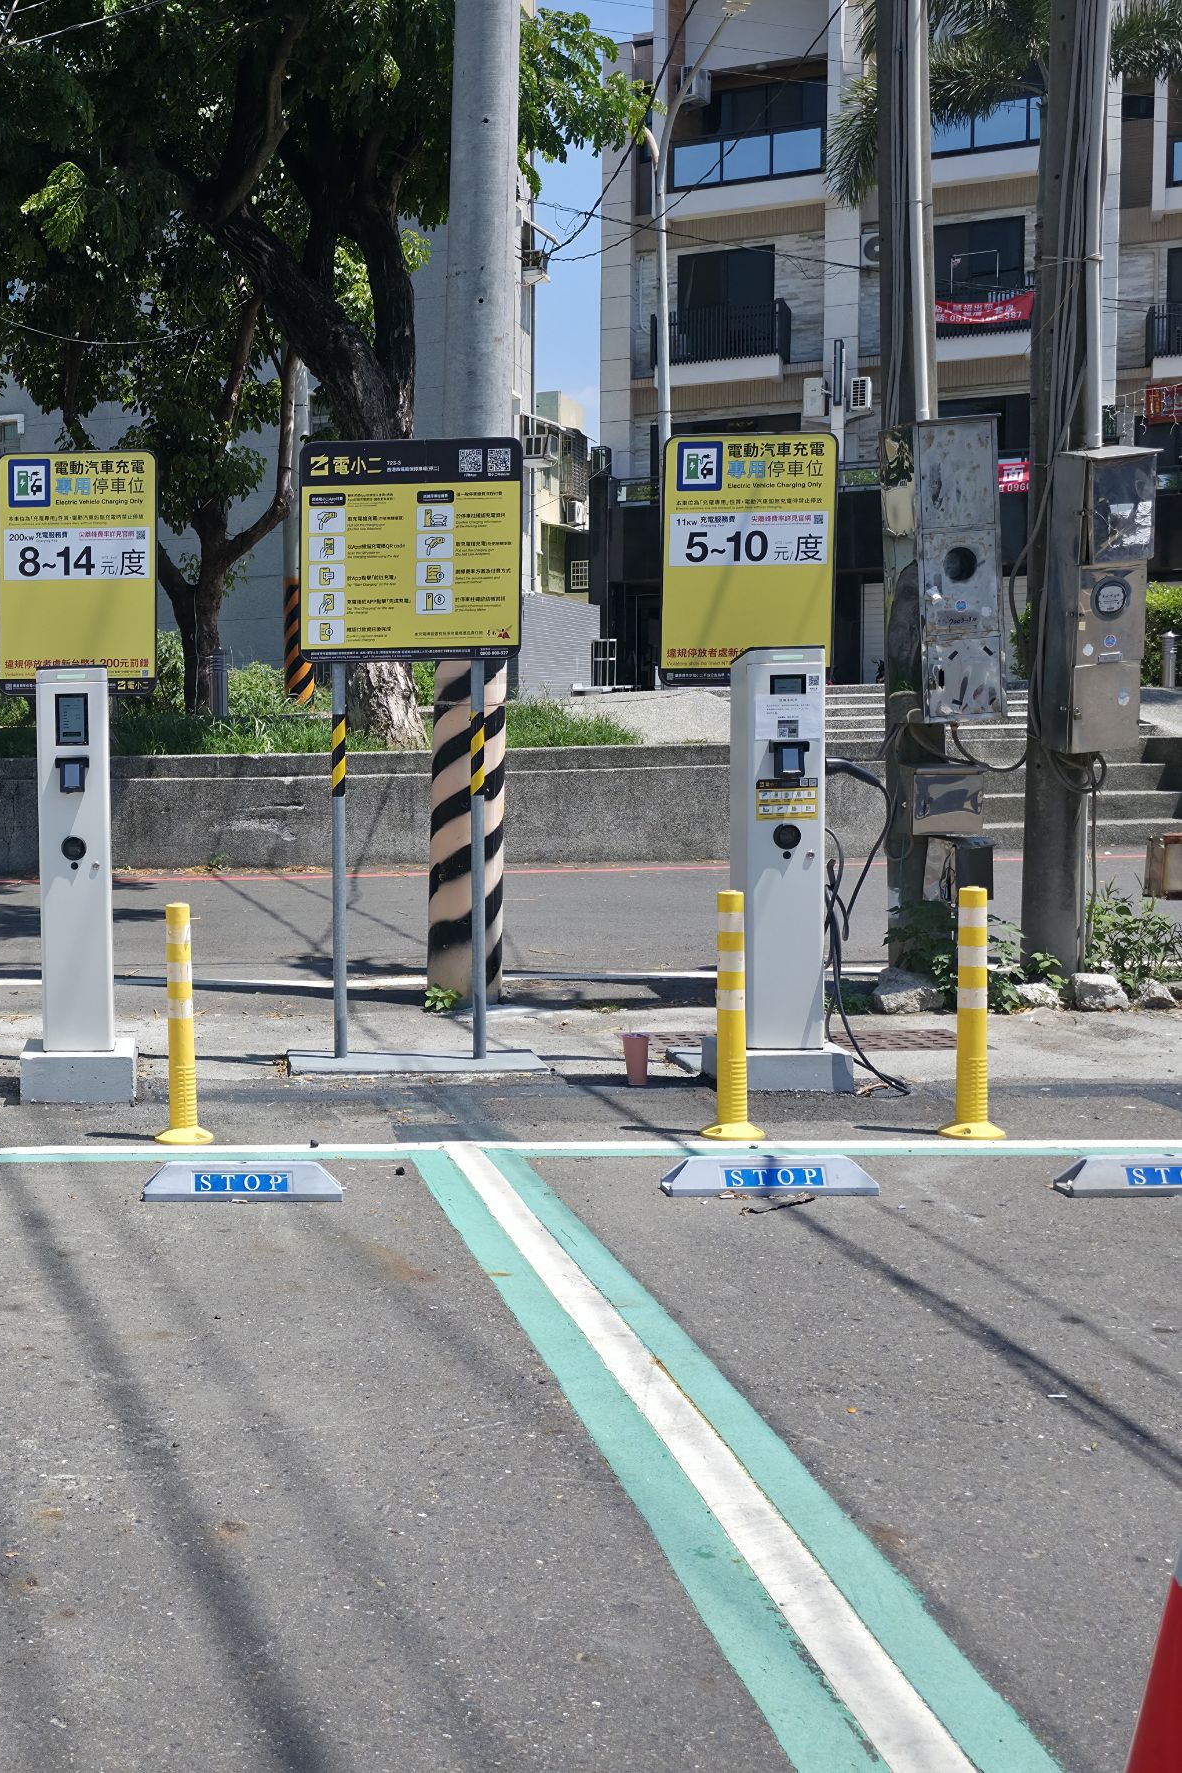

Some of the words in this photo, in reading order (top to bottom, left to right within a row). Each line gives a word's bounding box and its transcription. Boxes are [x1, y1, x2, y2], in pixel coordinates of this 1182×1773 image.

[727, 441, 825, 458] 電動汽車充電
[54, 459, 145, 475] 電動汽車充電
[332, 456, 382, 475] 電小二
[728, 460, 824, 479] 專用停車位
[55, 477, 144, 496] 專用停車位
[8, 534, 34, 542] 200KW
[685, 530, 768, 563] 5~10
[18, 546, 96, 577] 8~14
[4, 658, 150, 670] 違規停放者處新台幣1200元罰鍰
[127, 681, 149, 689] 電小二
[200, 1174, 282, 1191] STOP
[730, 1168, 817, 1187] STOP
[1132, 1168, 1182, 1185] ST
